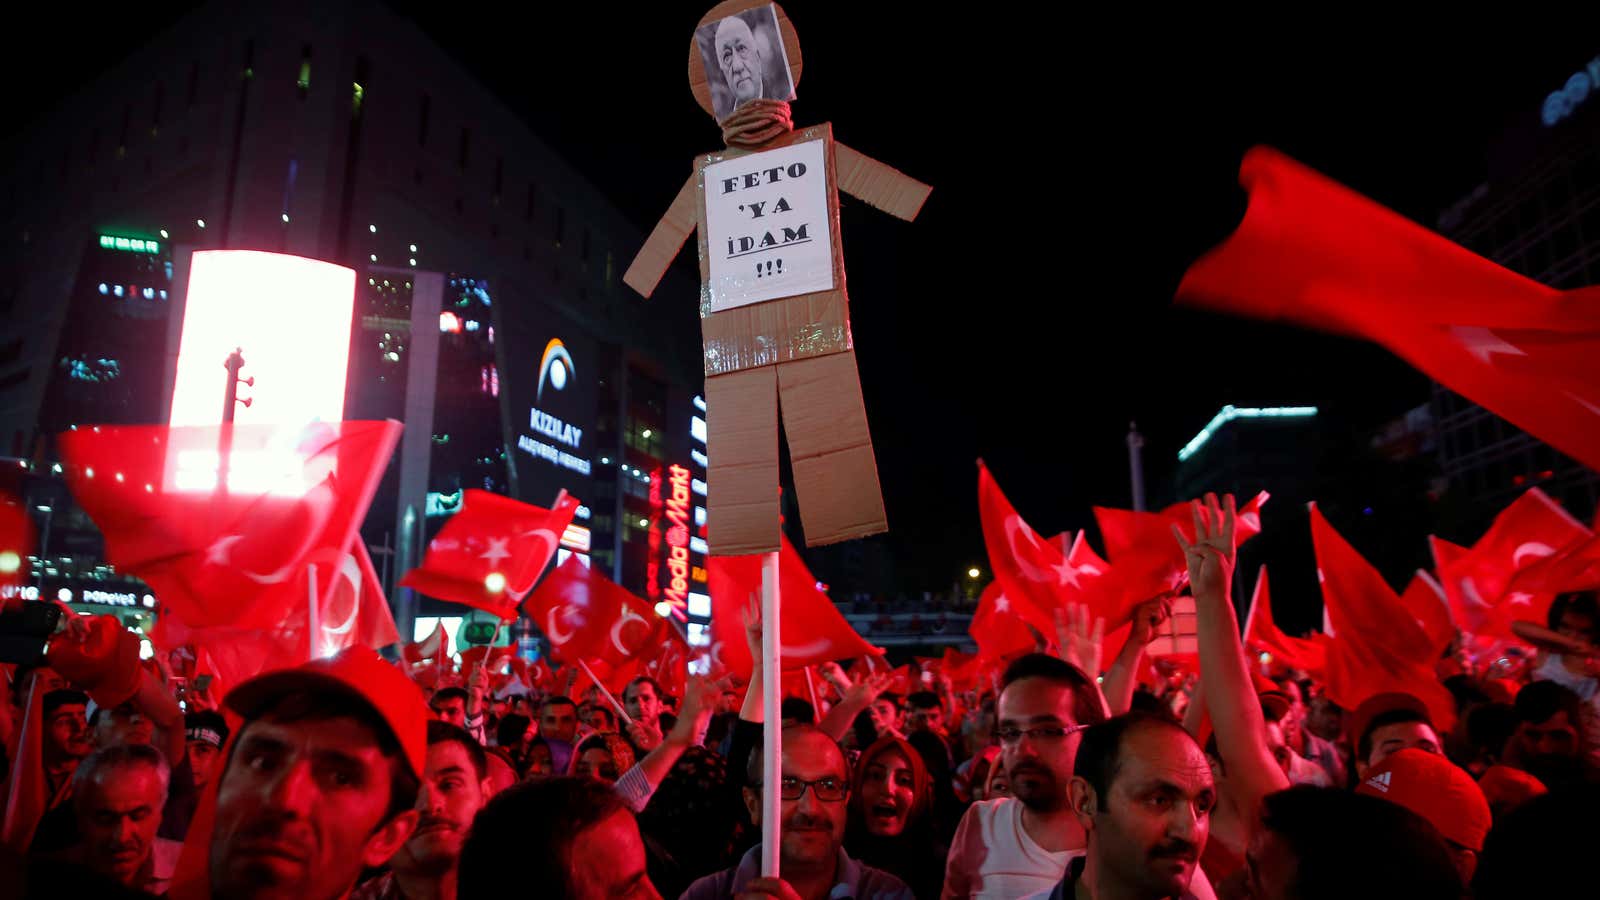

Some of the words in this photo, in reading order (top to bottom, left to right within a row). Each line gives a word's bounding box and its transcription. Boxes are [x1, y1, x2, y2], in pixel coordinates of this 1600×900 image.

[722, 162, 807, 195] FETO
[738, 197, 792, 219] 'YA
[727, 223, 811, 255] İDAM
[756, 258, 783, 278] !!!
[530, 407, 583, 448] KIZILAY
